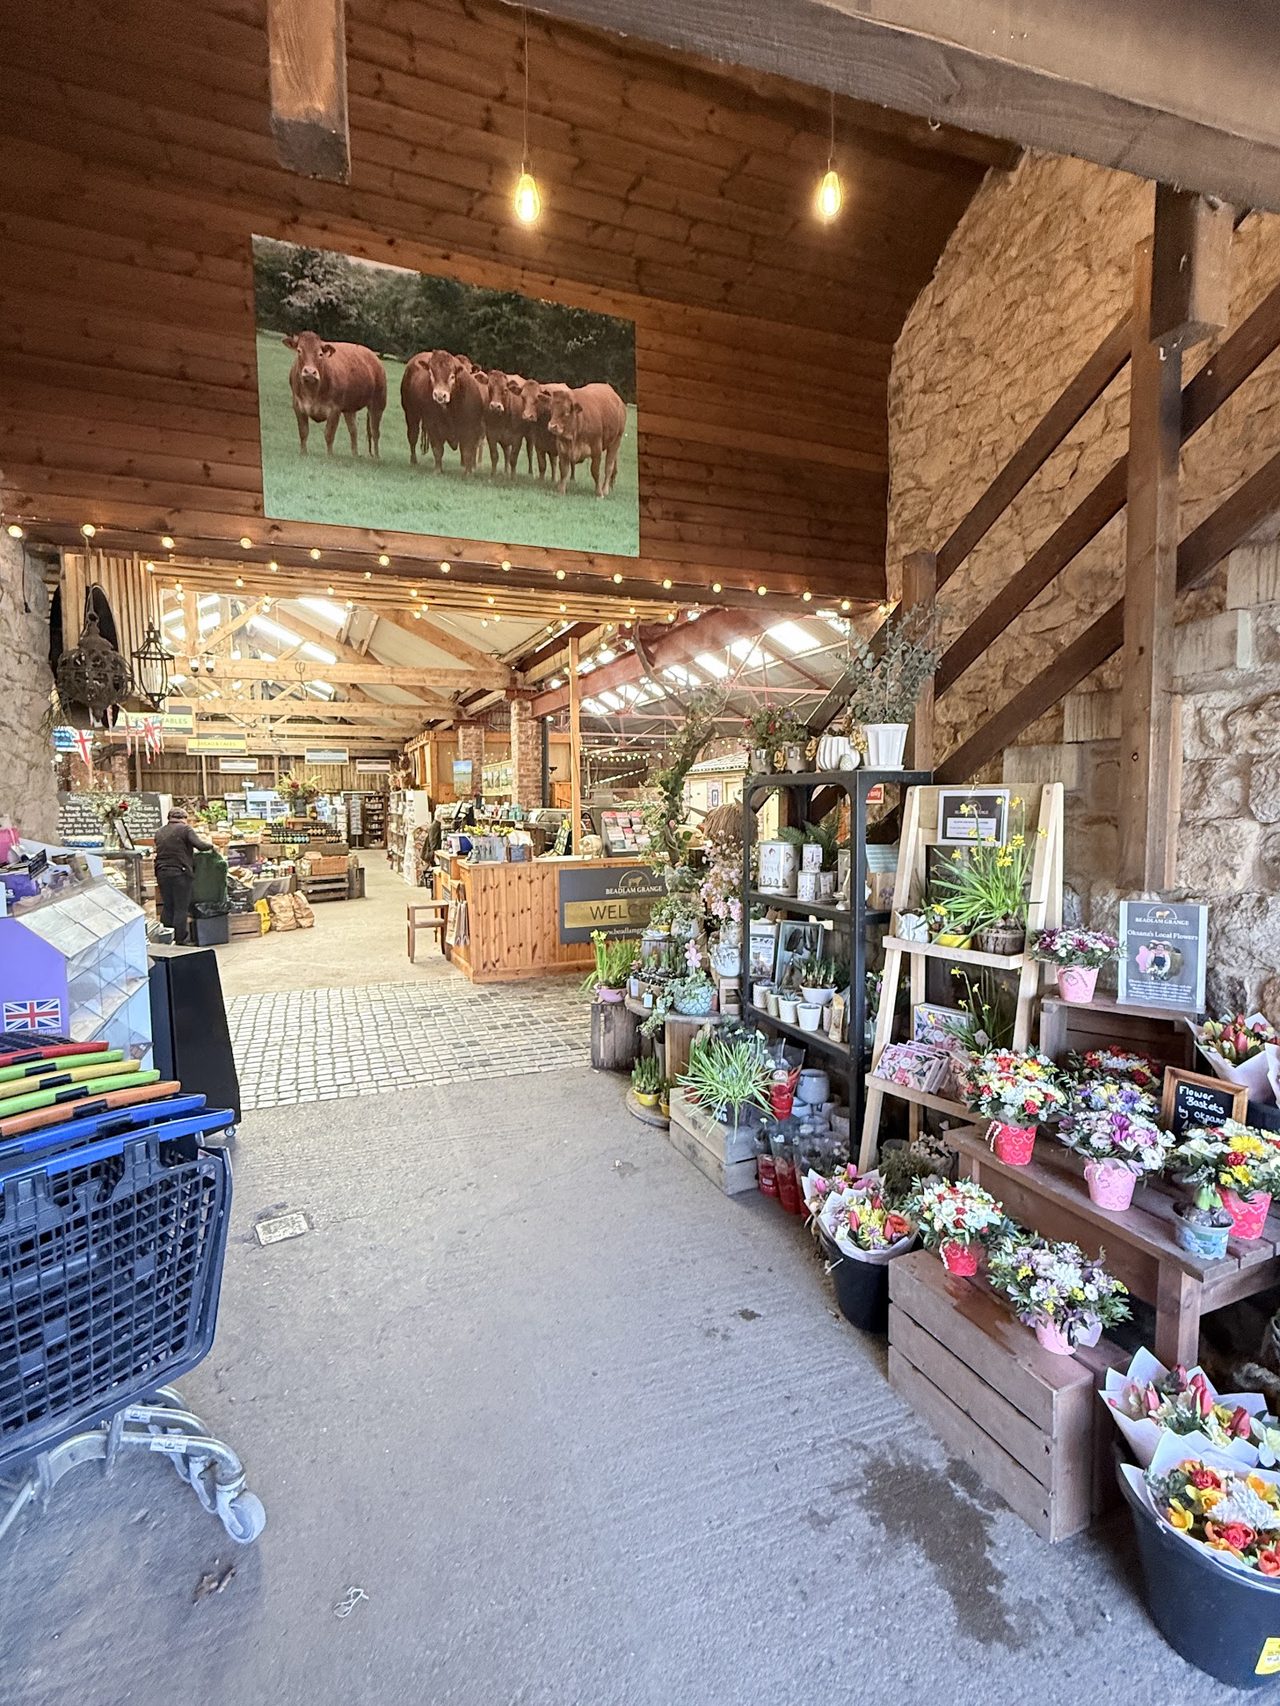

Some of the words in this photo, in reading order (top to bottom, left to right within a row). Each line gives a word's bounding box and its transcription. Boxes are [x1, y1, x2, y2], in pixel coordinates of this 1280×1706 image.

[605, 887, 637, 895] BEADLAM
[638, 885, 662, 893] GRANGE
[590, 903, 651, 921] WELCO
[1135, 917, 1163, 925] BEADLAM
[1127, 929, 1154, 938] Oksana's
[1173, 933, 1198, 941] Flowers
[1179, 1086, 1214, 1101] Flower
[1178, 1105, 1189, 1119] by
[1185, 1096, 1225, 1115] Baskets
